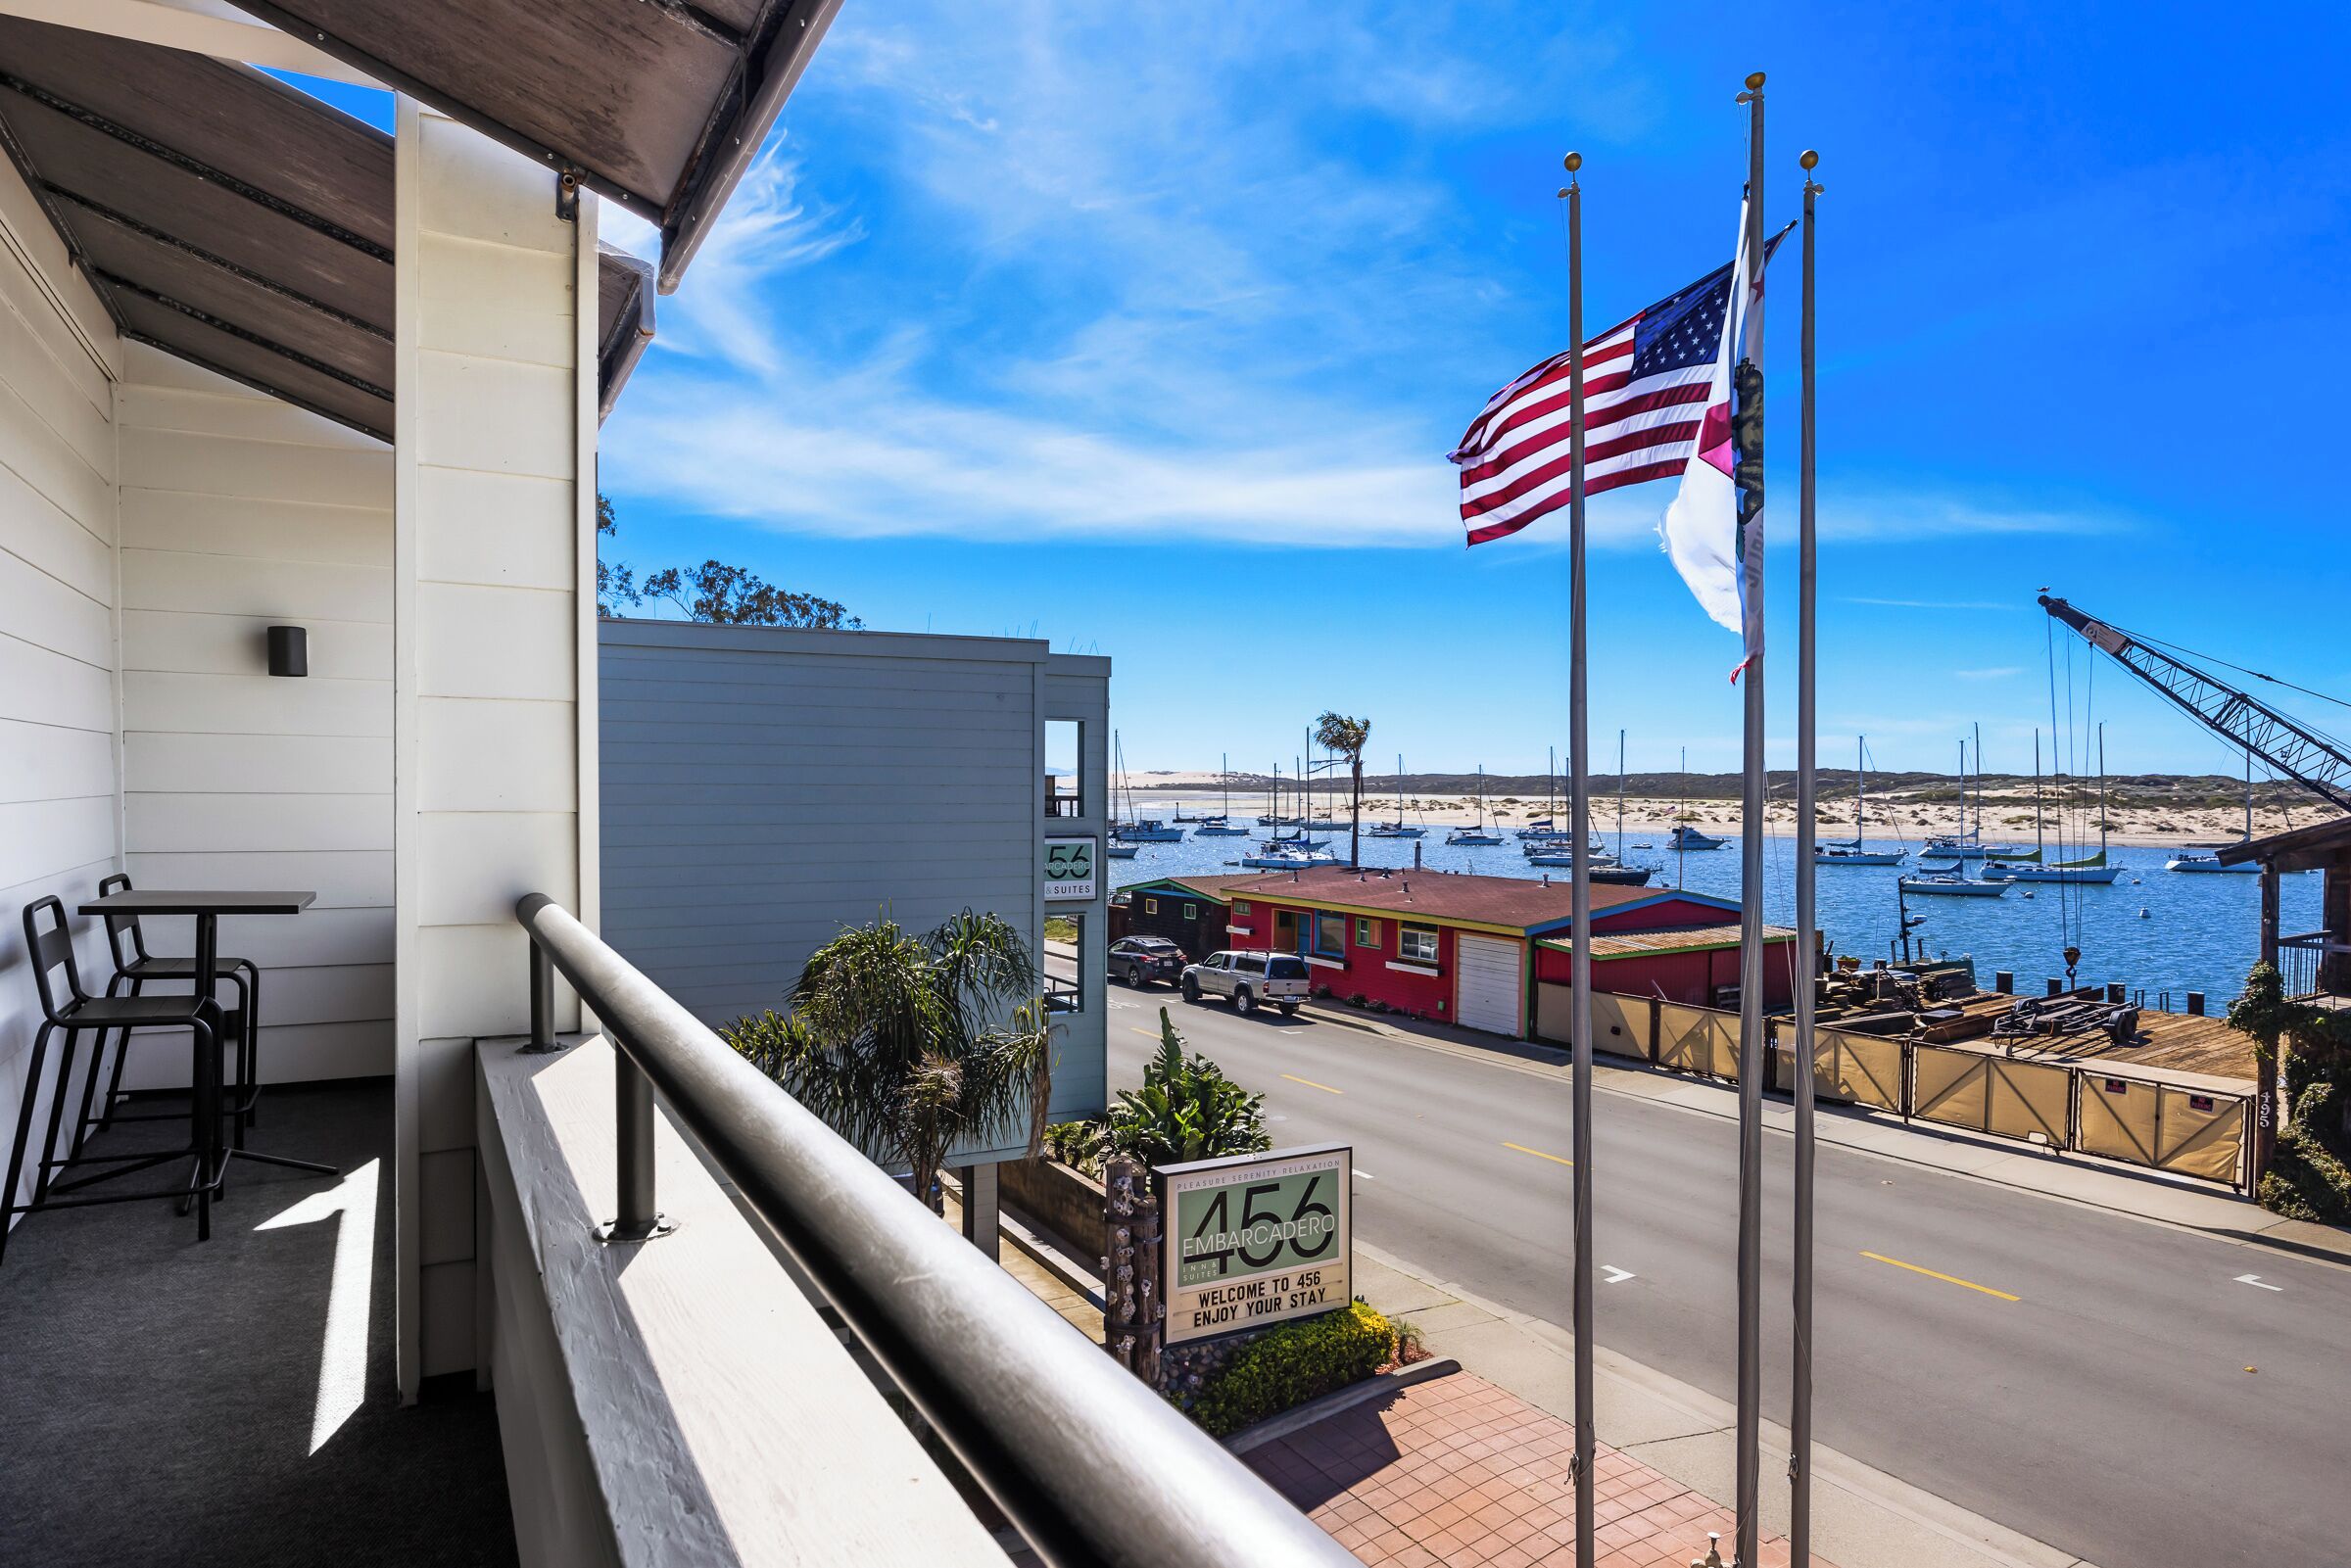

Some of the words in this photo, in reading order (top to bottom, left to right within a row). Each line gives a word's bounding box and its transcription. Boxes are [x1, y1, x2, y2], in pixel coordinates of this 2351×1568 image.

[1045, 845, 1090, 879] 56
[1054, 885, 1090, 894] SUITES
[2259, 1091, 2271, 1128] 495
[1176, 1177, 1225, 1190] PLEASURE
[1231, 1169, 1276, 1182] SERENITY
[1282, 1160, 1340, 1174] RELAXATION
[1182, 1214, 1335, 1258] EMBARCADERO
[1183, 1176, 1334, 1274] 456
[1182, 1262, 1207, 1273] INN
[1182, 1269, 1218, 1282] SUITES
[1198, 1281, 1266, 1308] WELCOME
[1272, 1276, 1289, 1293] TO
[1296, 1270, 1320, 1289] 456
[1193, 1305, 1238, 1328] ENJOY
[1247, 1296, 1282, 1316] YOUR
[1290, 1287, 1326, 1308] STAY
